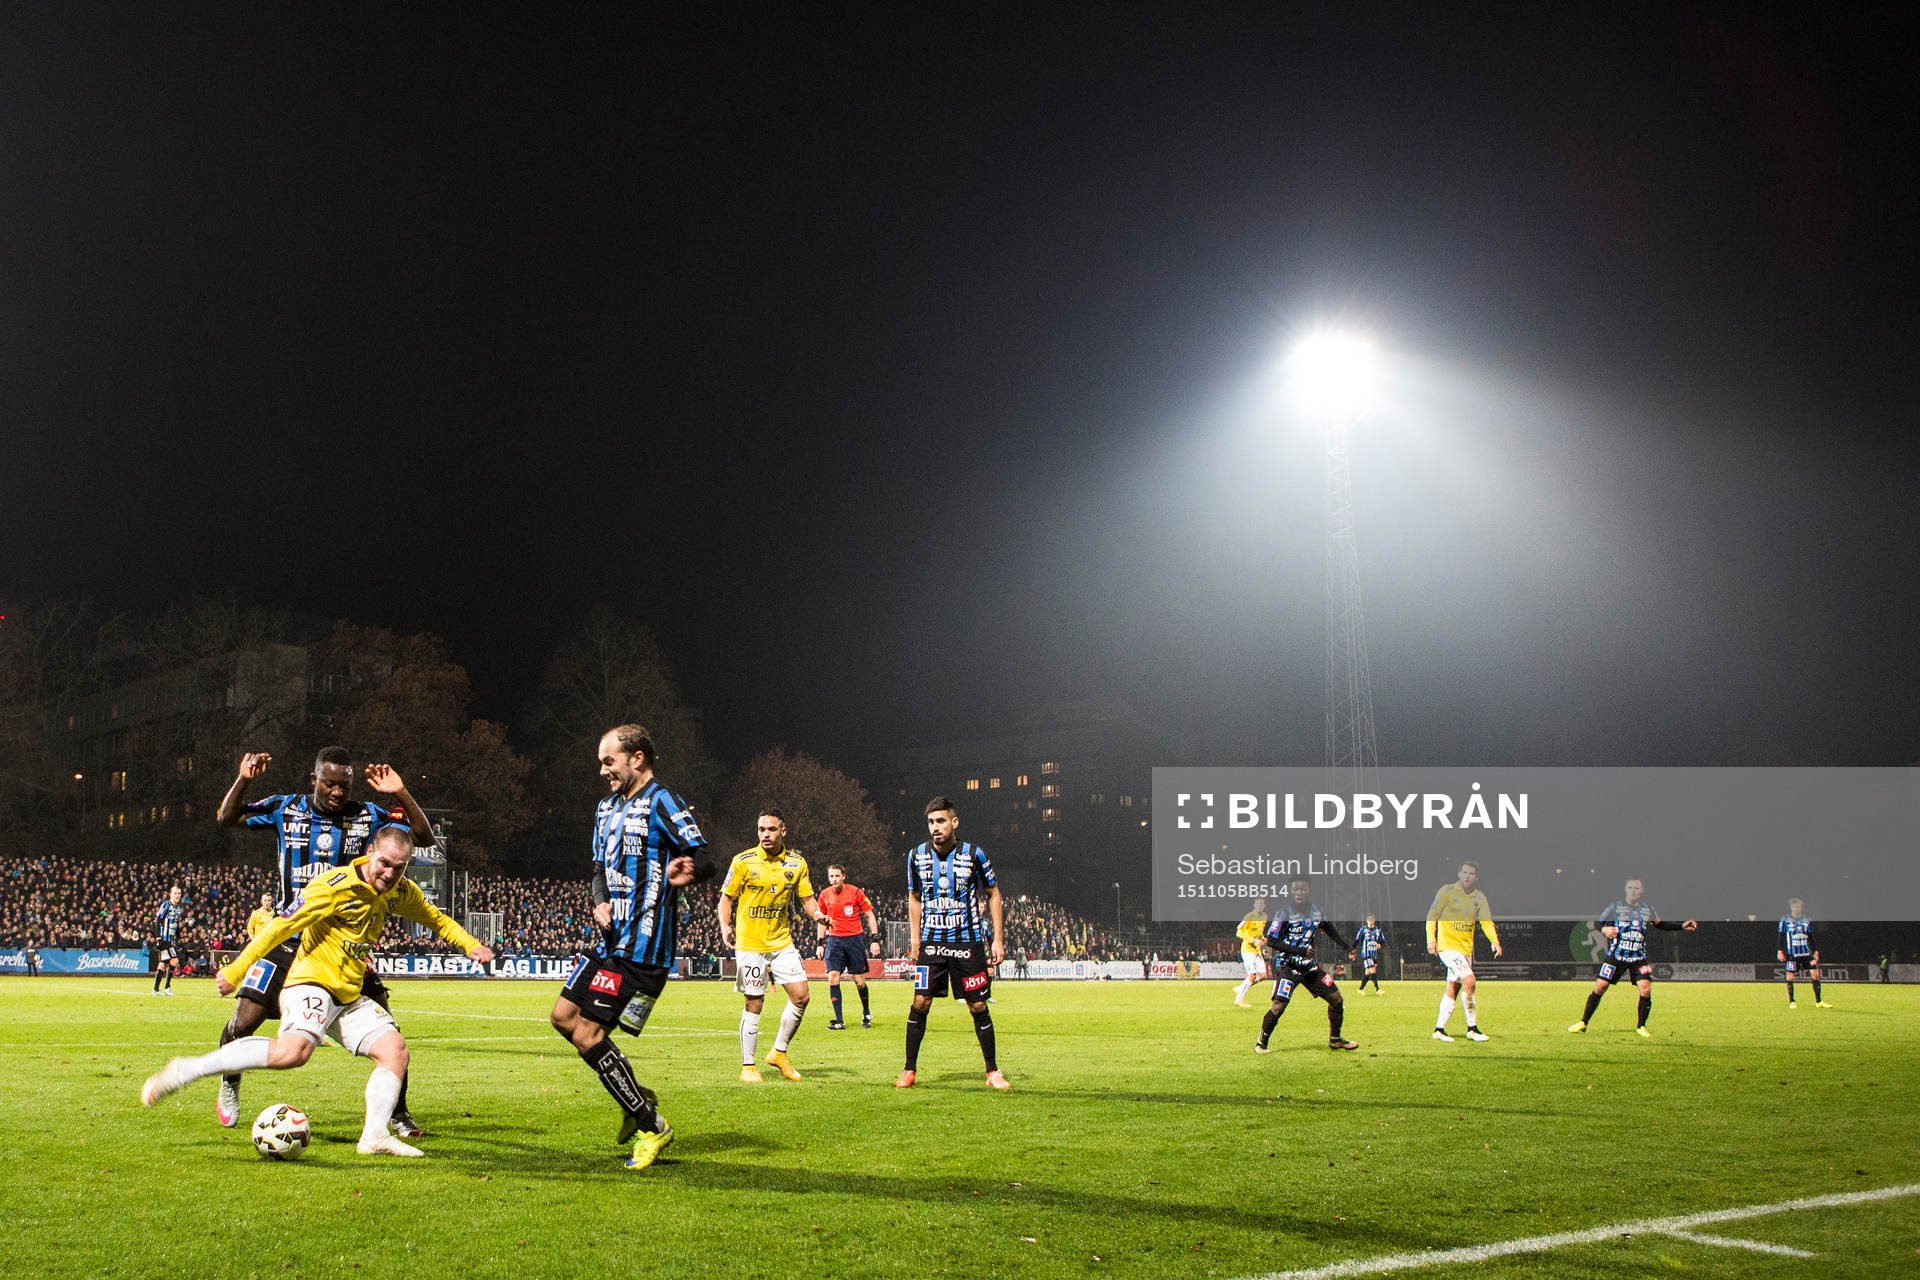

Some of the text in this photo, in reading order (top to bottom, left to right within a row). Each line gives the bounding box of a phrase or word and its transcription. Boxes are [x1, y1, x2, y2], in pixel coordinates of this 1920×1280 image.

[283, 822, 311, 834] UNT.
[623, 835, 642, 846] NOVA
[622, 845, 643, 856] PARK
[937, 945, 971, 959] Koneo
[76, 953, 140, 971] Basreklam
[374, 957, 408, 975] NS
[414, 956, 486, 975] BÄSTA
[489, 959, 531, 976] LAG
[744, 965, 761, 979] 70
[1001, 964, 1071, 976] Halsbanken
[965, 974, 988, 992] JÖTA
[302, 996, 324, 1013] 12
